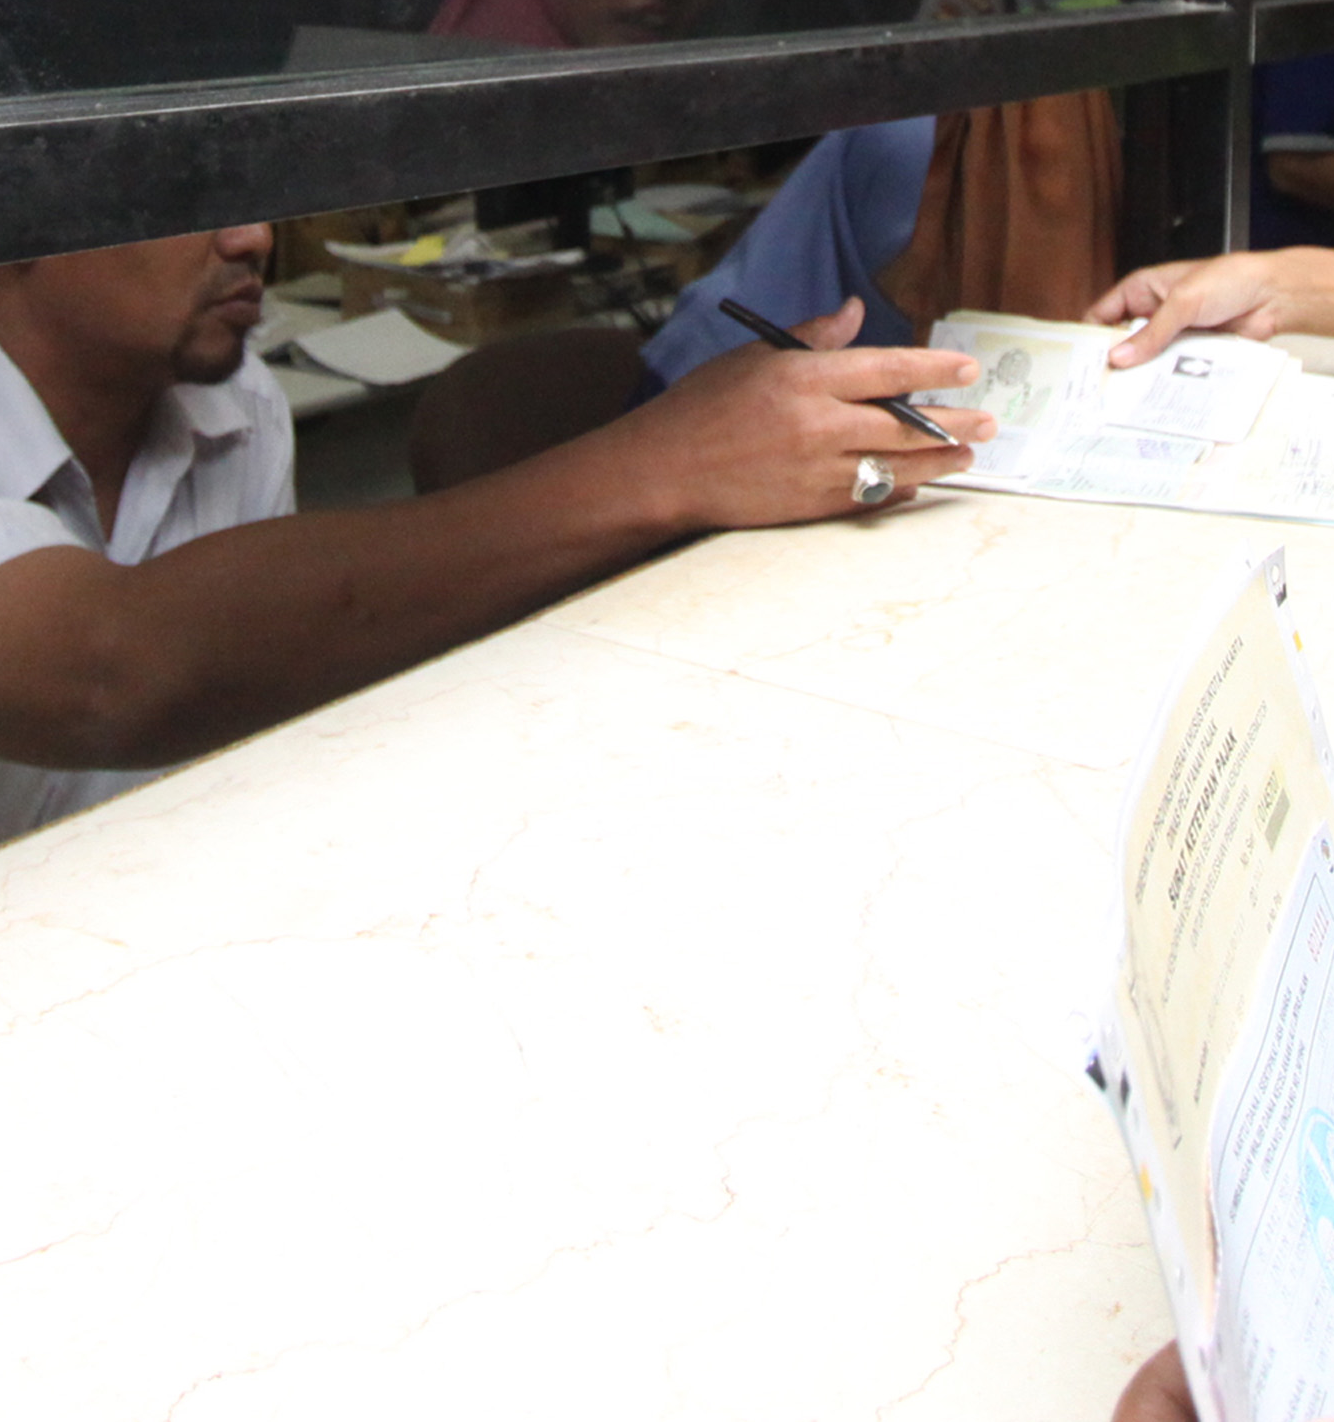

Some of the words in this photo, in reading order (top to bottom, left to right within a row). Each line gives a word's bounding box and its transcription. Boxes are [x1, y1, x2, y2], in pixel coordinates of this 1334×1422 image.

[1167, 849, 1186, 910] SURAT
[1184, 770, 1218, 857] KETETAPAN
[1215, 727, 1237, 778] PAJAK
